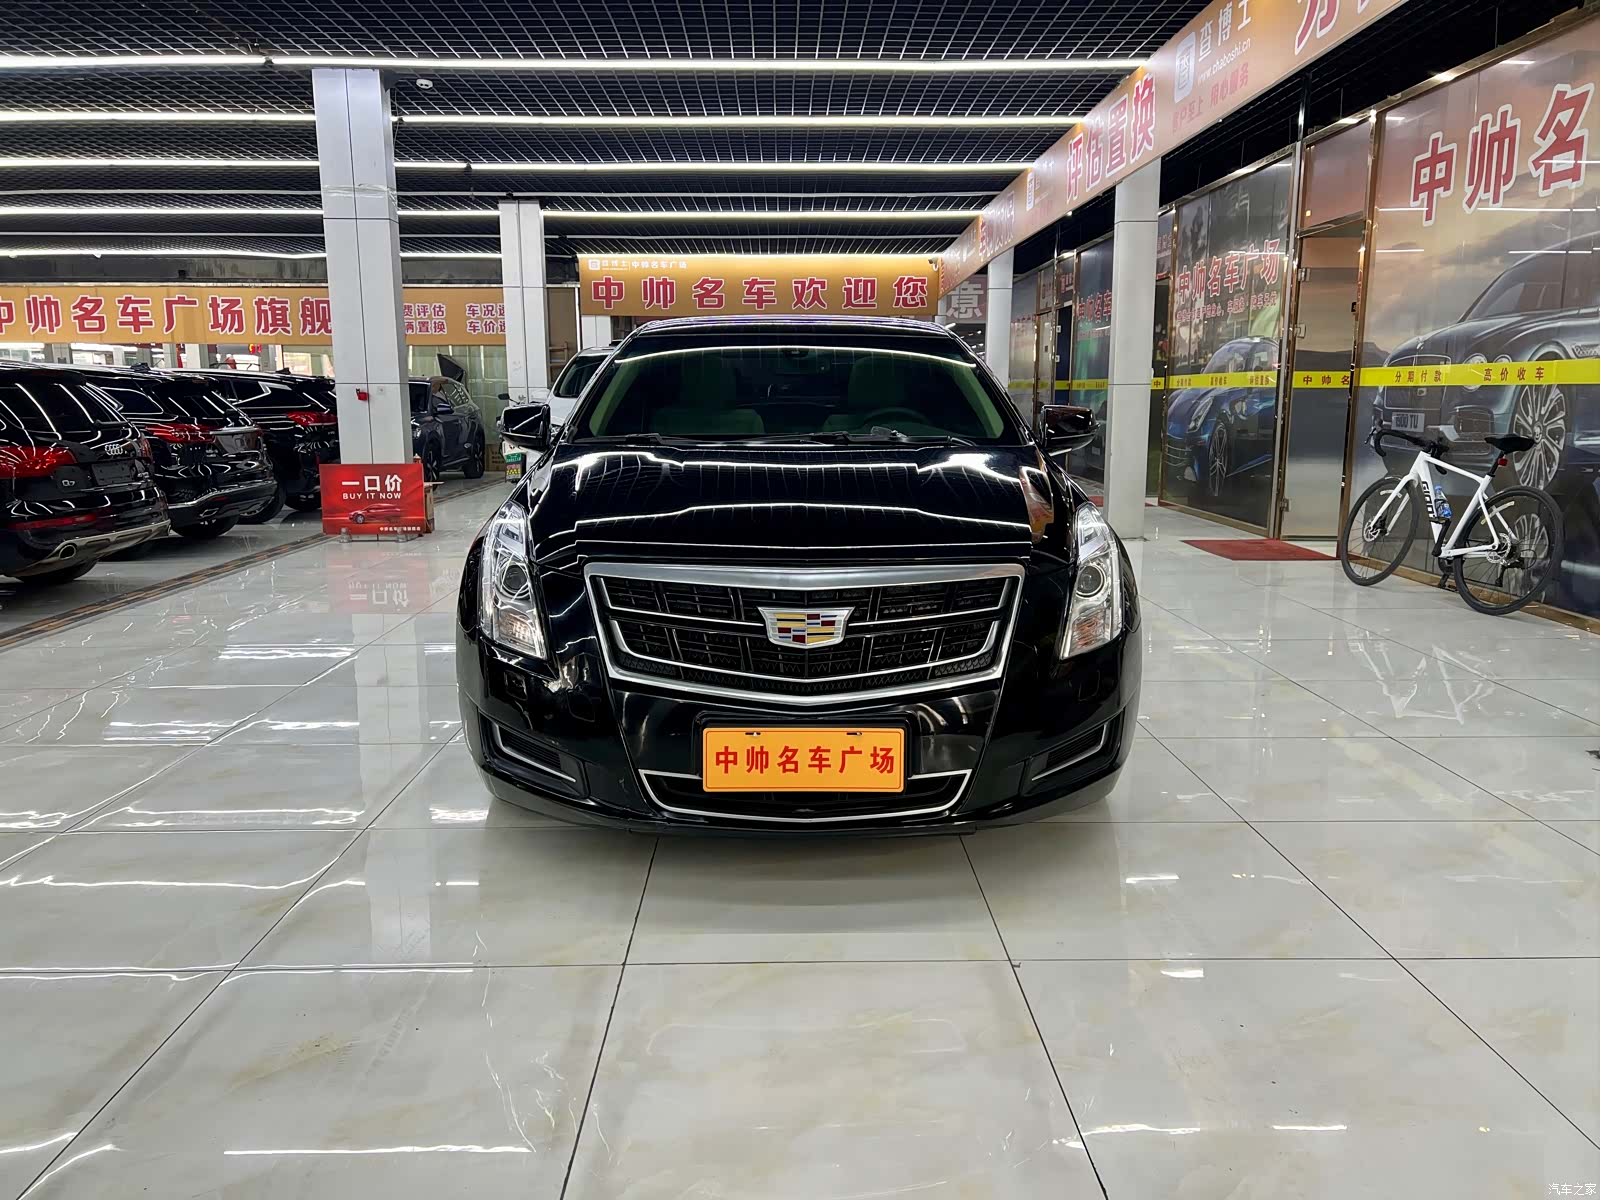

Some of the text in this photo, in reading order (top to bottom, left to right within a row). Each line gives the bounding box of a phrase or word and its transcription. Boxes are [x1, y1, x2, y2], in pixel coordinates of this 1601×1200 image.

[1067, 73, 1156, 205] 评估置换
[1410, 82, 1595, 227] 中帅名
[1178, 239, 1281, 304] 中帅名车广场
[591, 275, 928, 311] 中帅名车欢迎您
[1303, 375, 1350, 386] 中帅名
[1395, 367, 1545, 383] 分期付款 高价收车
[341, 474, 402, 492] 一口价
[342, 492, 402, 500] BUY IT NOW
[715, 745, 895, 774] 中帅名车广场
